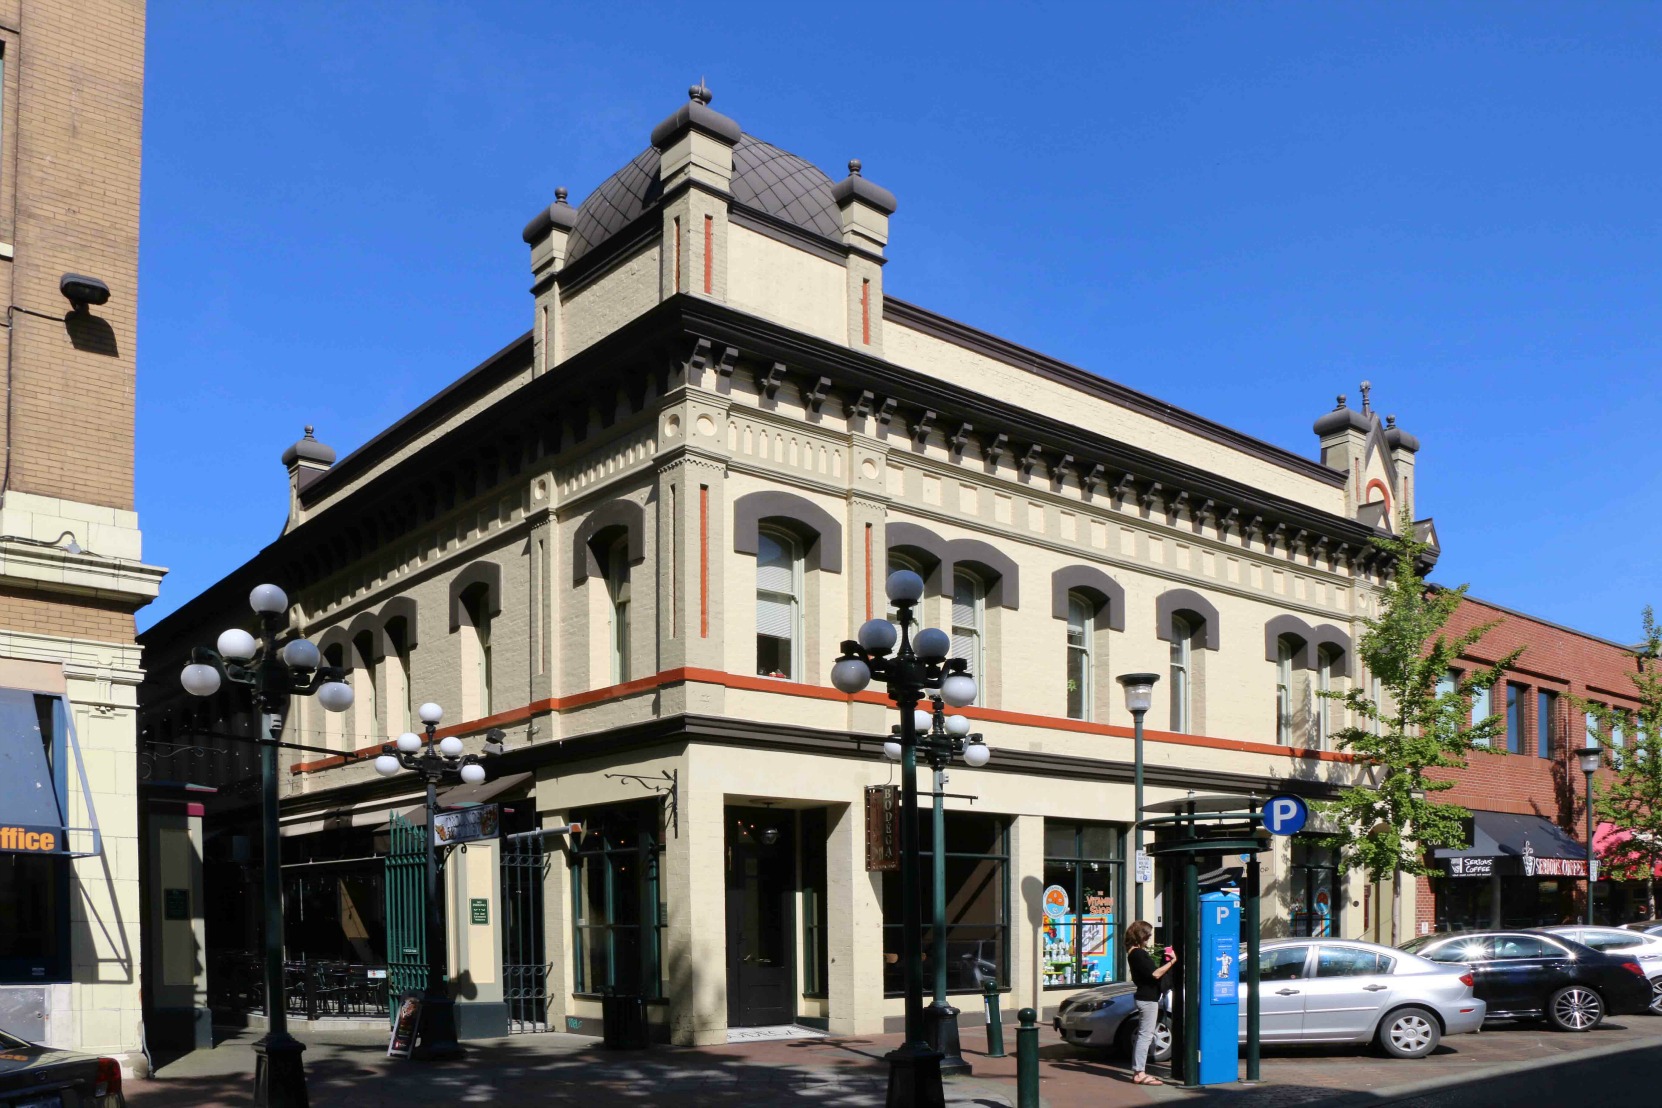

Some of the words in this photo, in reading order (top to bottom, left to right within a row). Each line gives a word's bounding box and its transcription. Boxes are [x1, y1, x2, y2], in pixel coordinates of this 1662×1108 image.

[884, 788, 893, 858] BODEGA
[1273, 799, 1297, 831] P
[1465, 865, 1491, 873] COFFEE
[1216, 906, 1230, 925] P
